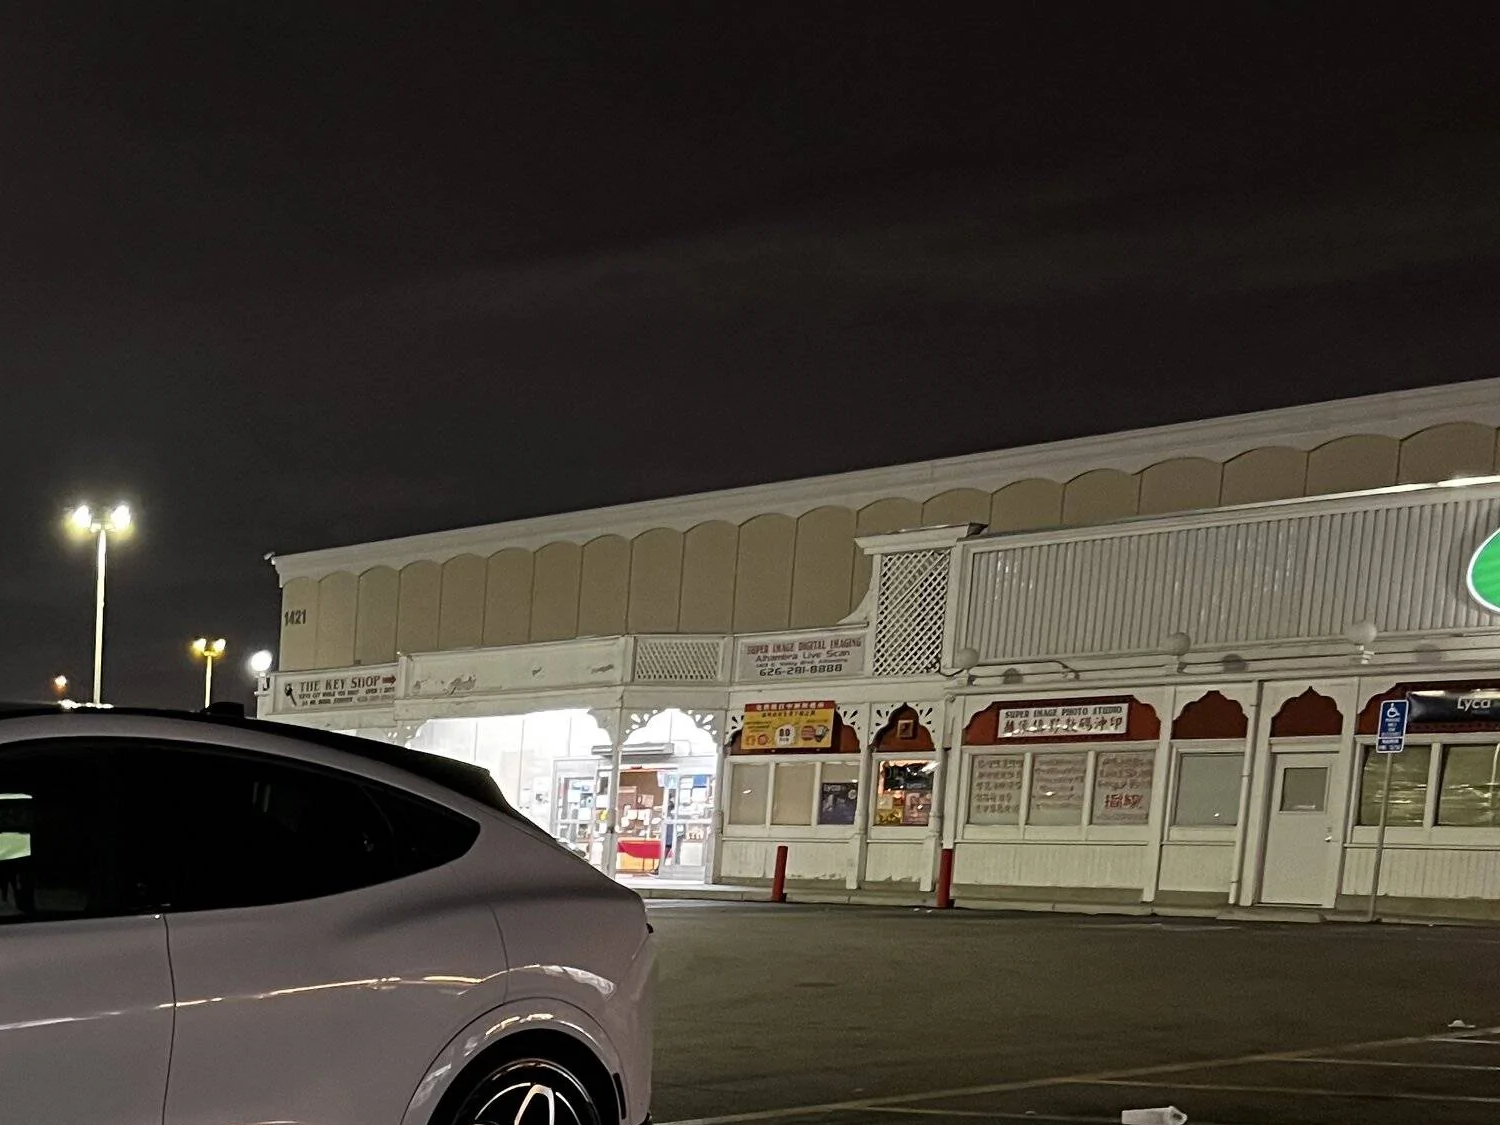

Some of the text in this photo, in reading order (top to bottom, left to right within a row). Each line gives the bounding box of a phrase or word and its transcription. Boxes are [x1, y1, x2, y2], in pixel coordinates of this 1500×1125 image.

[747, 645, 769, 655] SUPER
[826, 649, 851, 658] Scan
[300, 676, 380, 692] THE KEY SHOP
[1061, 707, 1089, 716] PHOTO
